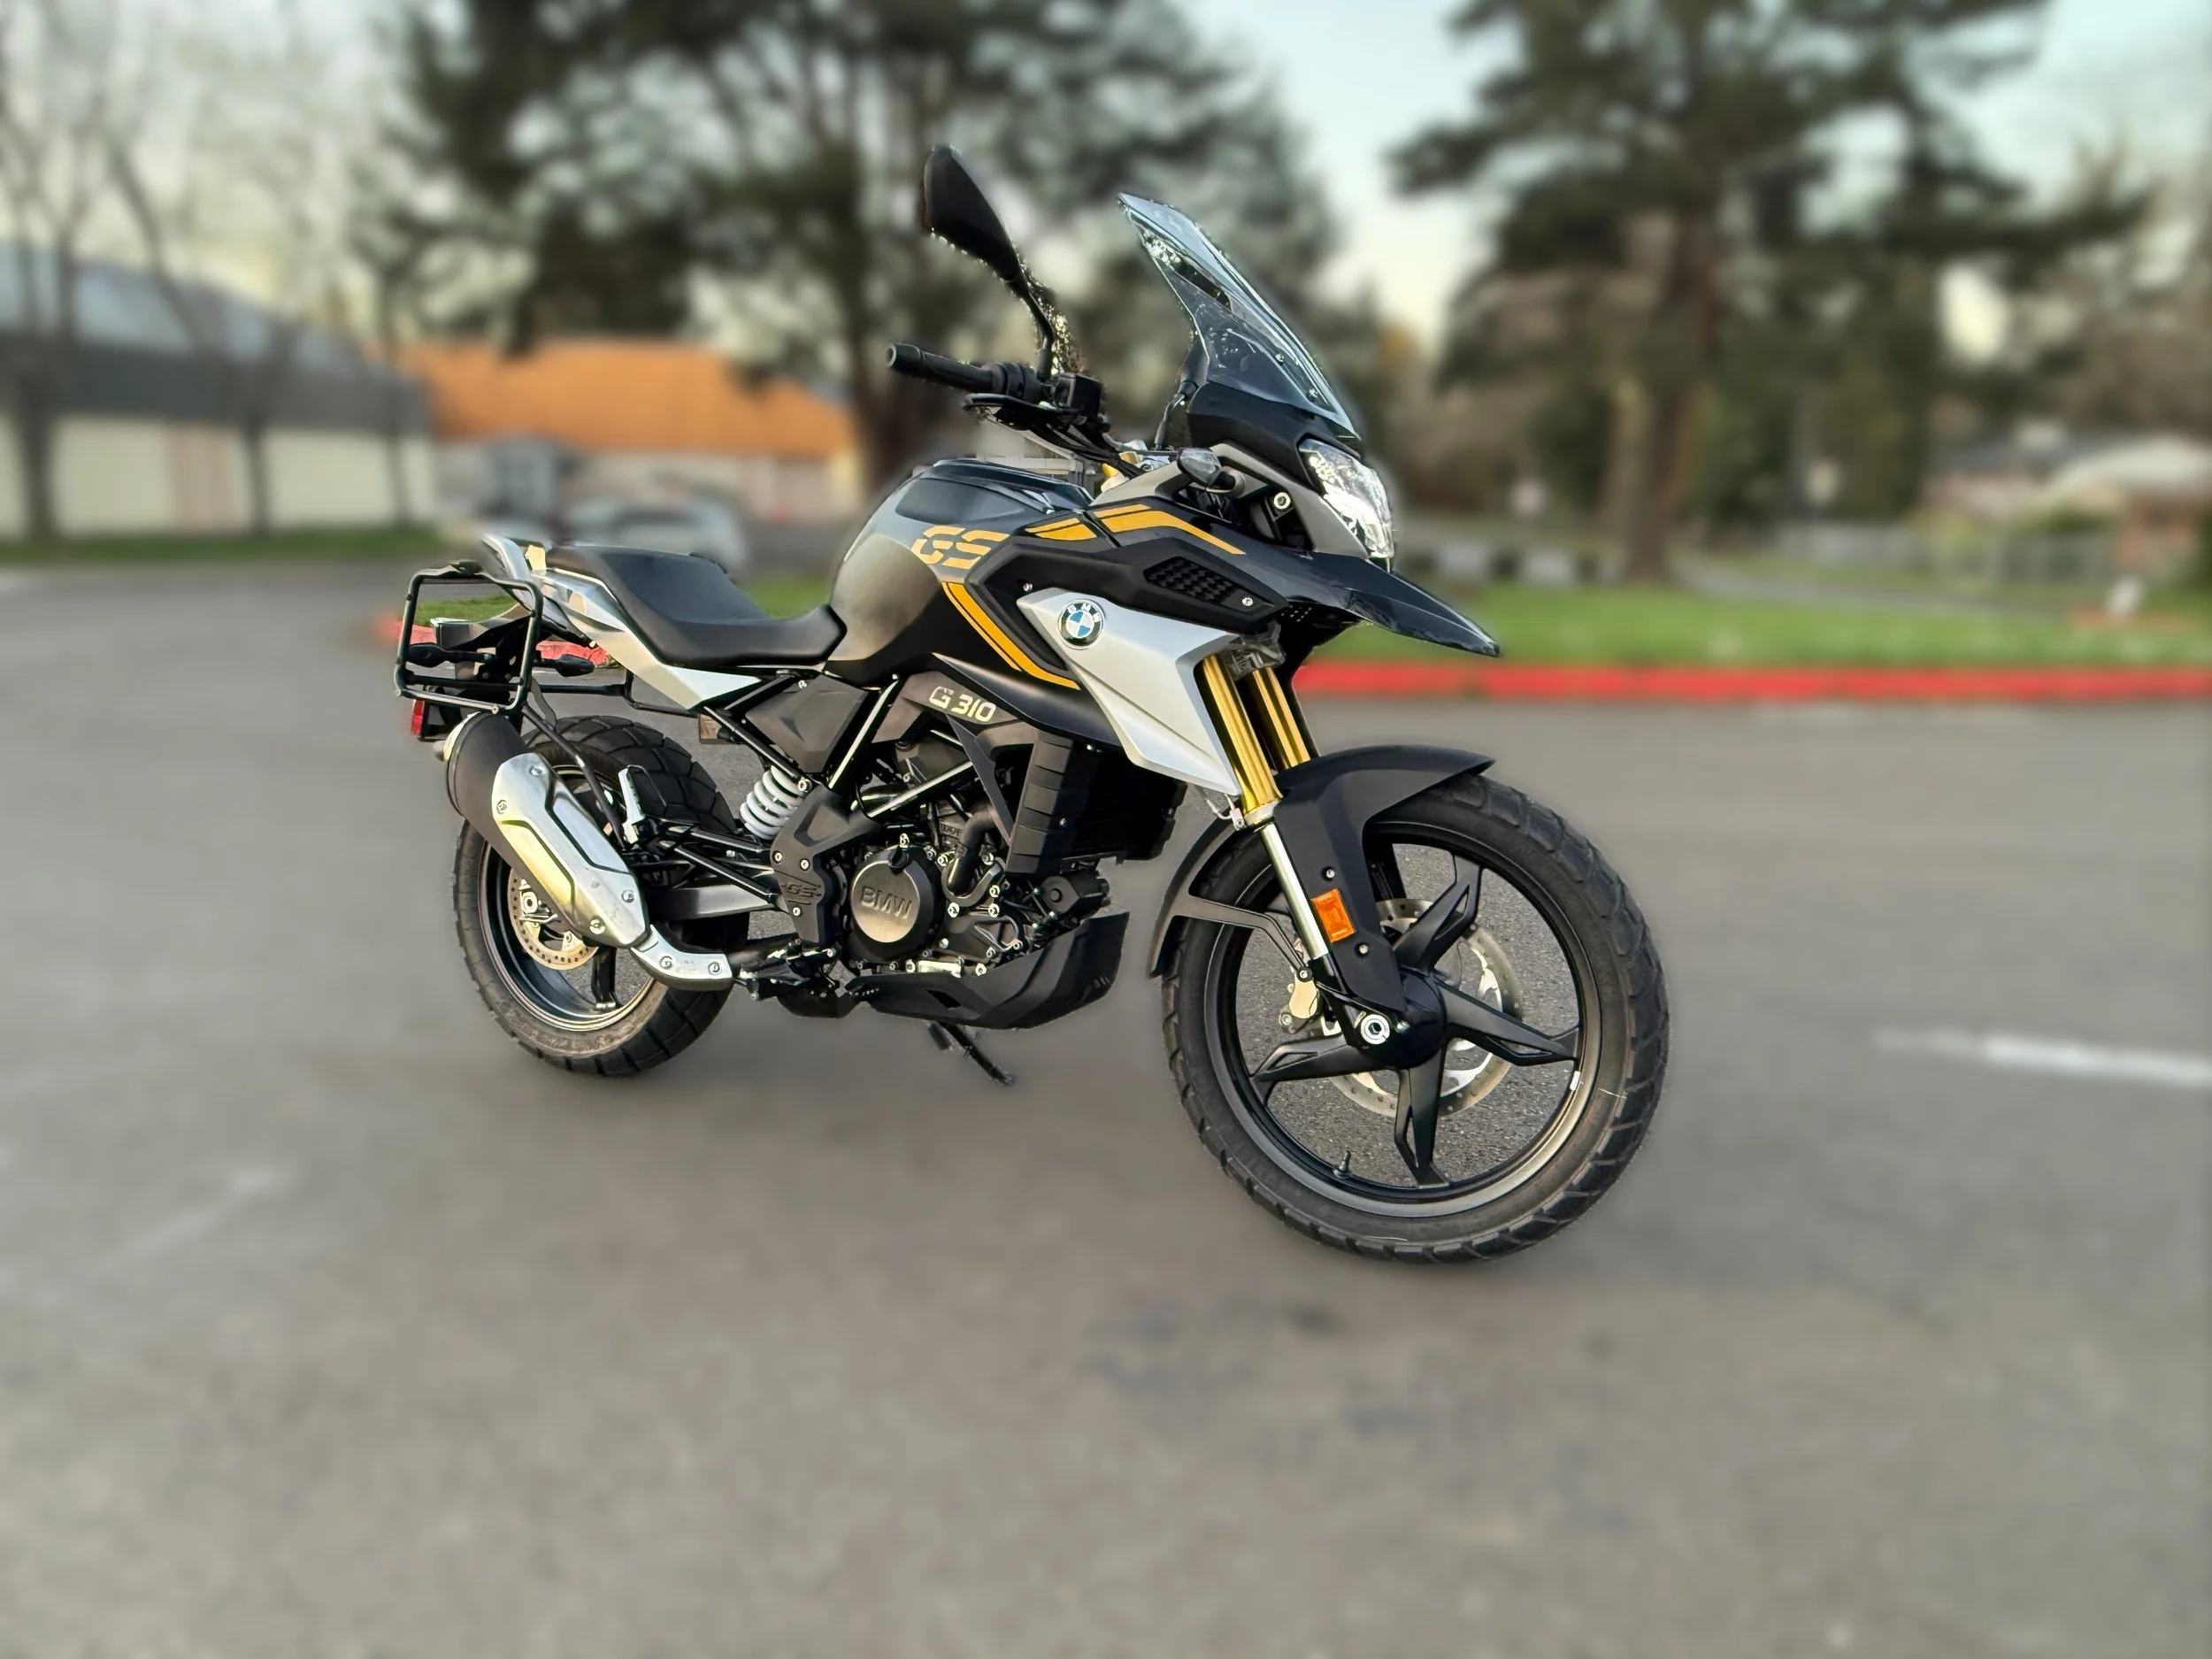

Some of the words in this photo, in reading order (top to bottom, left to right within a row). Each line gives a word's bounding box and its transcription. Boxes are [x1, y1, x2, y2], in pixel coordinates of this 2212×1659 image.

[910, 525, 1010, 570] GS
[1067, 603, 1102, 623] BMW
[928, 686, 955, 710] G
[951, 693, 997, 723] 310
[861, 886, 913, 919] BMW
